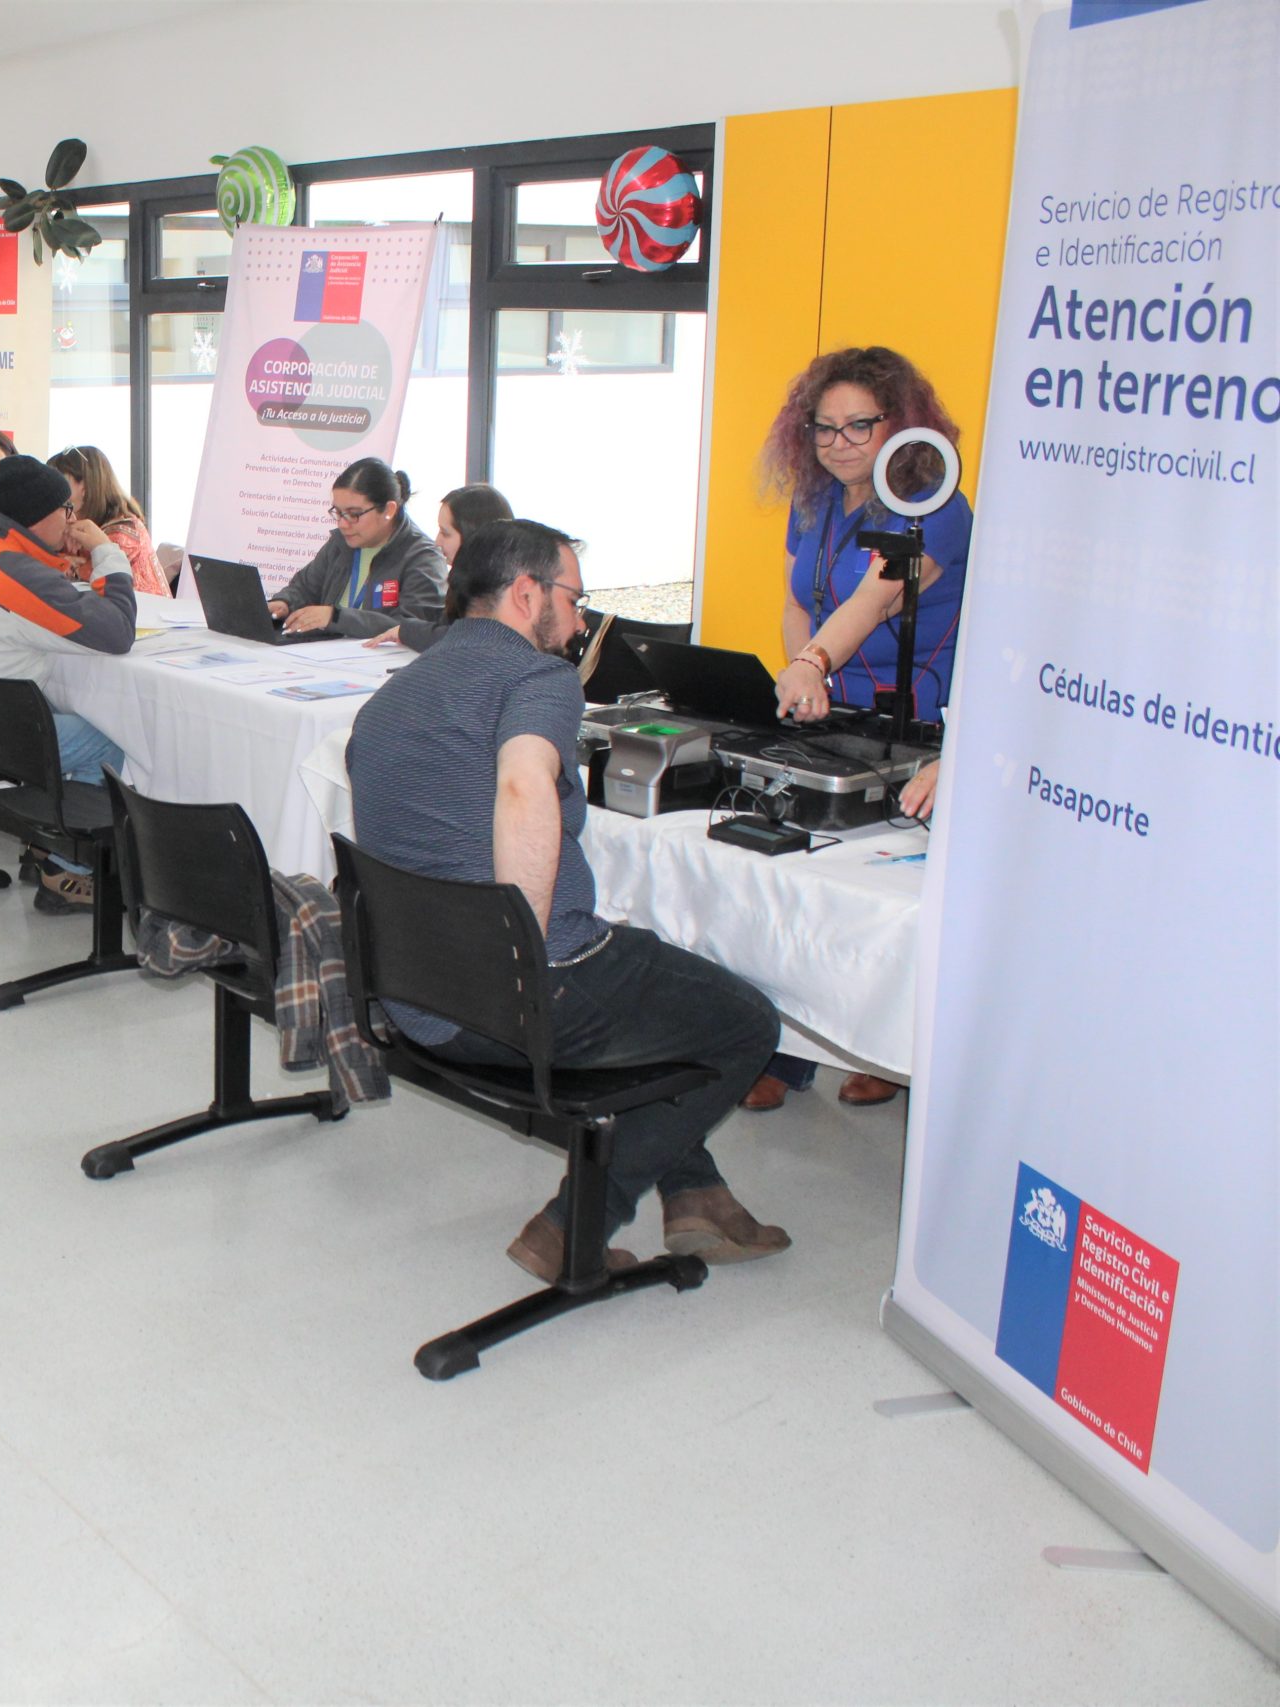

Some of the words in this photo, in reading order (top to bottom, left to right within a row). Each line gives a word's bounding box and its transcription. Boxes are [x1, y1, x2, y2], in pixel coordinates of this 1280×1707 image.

[1039, 190, 1131, 225] Servicio
[1138, 187, 1168, 218] de
[1035, 246, 1050, 267] e
[1059, 230, 1222, 267] Identificación
[1028, 282, 1253, 343] Atención
[264, 360, 358, 379] CORPORACIÓN
[361, 365, 379, 379] DE
[249, 380, 324, 397] ASISTENCIA
[327, 384, 385, 400] JUDICIAL
[1025, 365, 1083, 410] en
[1098, 360, 1280, 424] terreno
[277, 409, 308, 421] Acceso
[319, 411, 328, 422] la
[327, 411, 366, 425] Justicia!
[245, 463, 281, 473] Prevención
[281, 466, 290, 474] de
[291, 467, 323, 477] Conflictos
[324, 471, 329, 479] y
[260, 454, 299, 464] Actividades
[299, 457, 342, 468] Comunitarias
[1019, 439, 1256, 484] www.registrocivil.cl
[239, 490, 277, 501] Orientación
[292, 479, 322, 489] Derechos
[241, 507, 269, 518] Solución
[270, 510, 310, 523] Colaborativa
[311, 515, 319, 523] de
[257, 526, 305, 539] Representación
[247, 543, 275, 553] Atención
[276, 547, 301, 557] Integral
[1039, 663, 1135, 718] Cédulas
[1143, 693, 1176, 729] de
[1028, 765, 1150, 837] Pasaporte
[1084, 1215, 1133, 1257] Servicio
[1135, 1249, 1151, 1270] de
[1079, 1252, 1164, 1323] Identificación
[1082, 1233, 1130, 1276] Registro
[1131, 1267, 1160, 1298] Civil
[1161, 1290, 1170, 1304] e
[1074, 1291, 1081, 1302] y
[1081, 1294, 1116, 1327] Derechos
[1116, 1319, 1153, 1354] Humanos
[1076, 1276, 1116, 1311] Ministerio
[1116, 1305, 1127, 1319] de
[1128, 1312, 1158, 1341] Justicia
[1061, 1387, 1102, 1428] Gobierno
[1103, 1421, 1116, 1440] de
[1117, 1432, 1144, 1461] Chile
